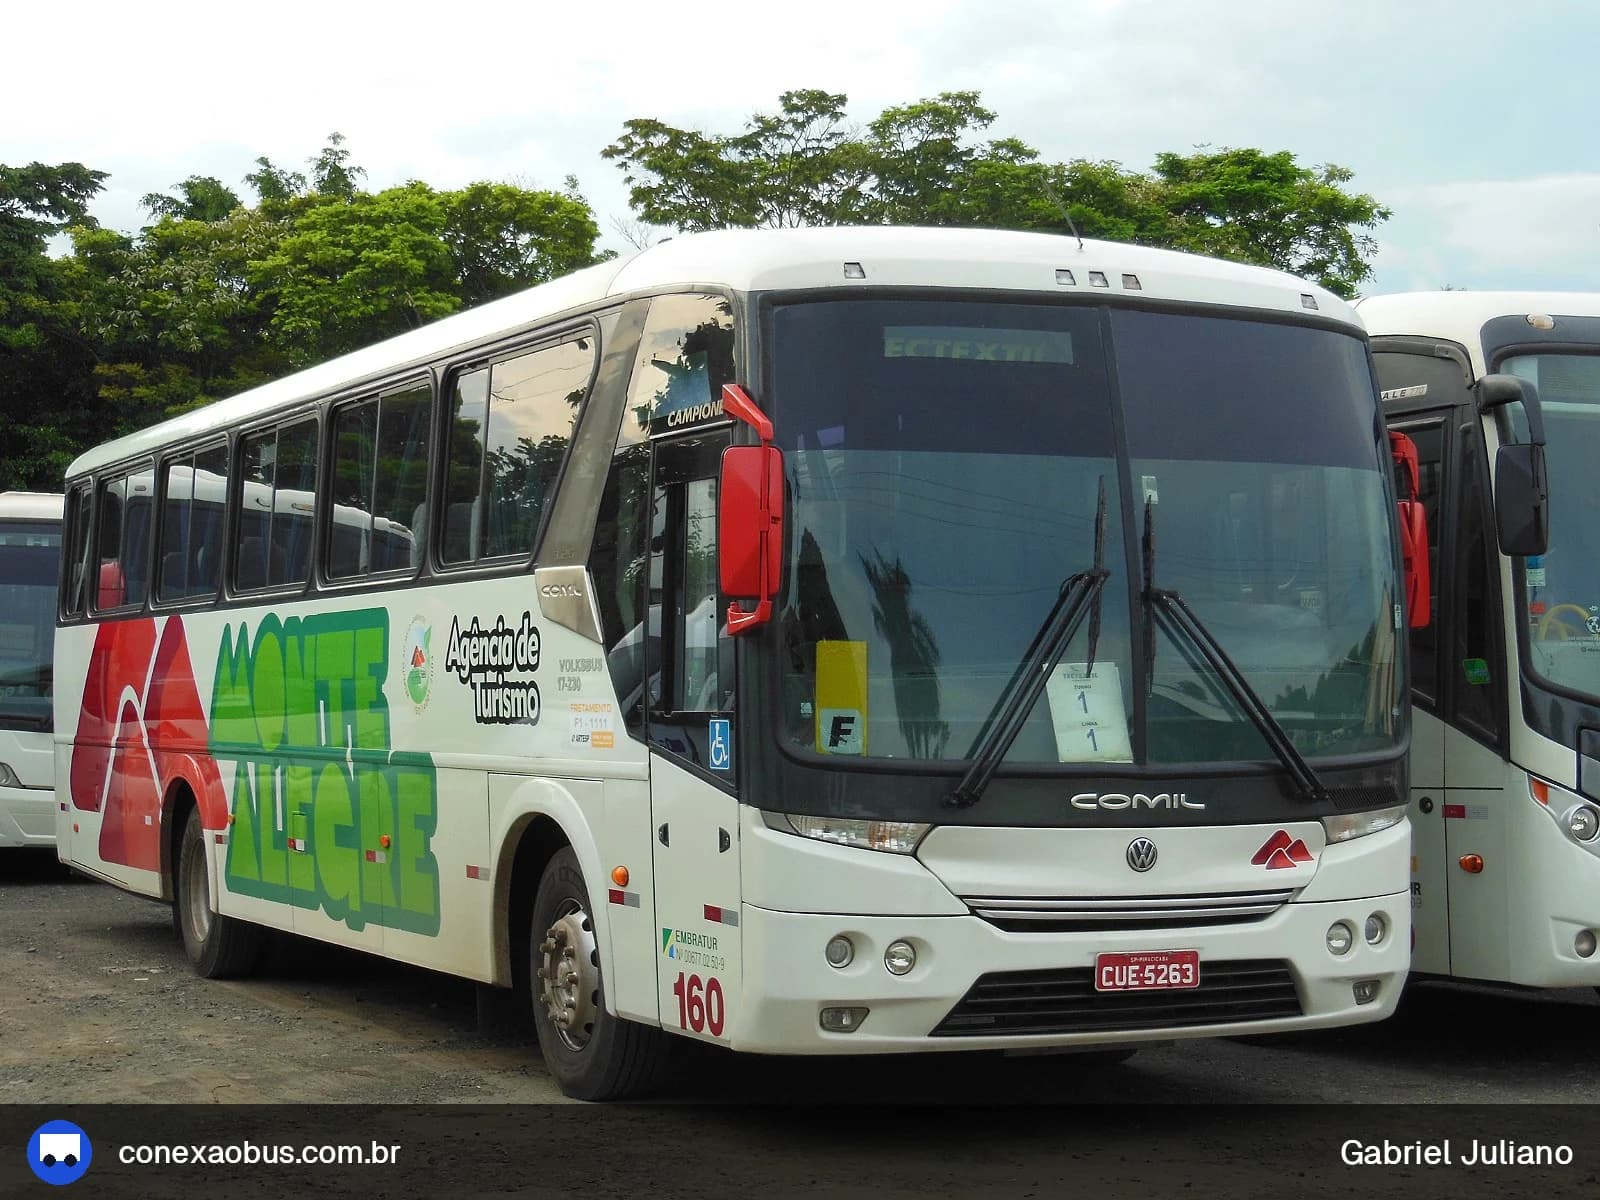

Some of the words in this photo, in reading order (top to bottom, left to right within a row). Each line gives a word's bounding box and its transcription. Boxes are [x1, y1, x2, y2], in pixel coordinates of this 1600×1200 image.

[446, 614, 514, 684] Agência
[515, 611, 540, 672] de
[209, 609, 391, 751] MONTE
[470, 671, 540, 726] Turismo
[1078, 691, 1088, 713] 1
[828, 716, 855, 747] F
[1087, 728, 1098, 752] 1
[1071, 793, 1206, 810] COMIL
[225, 754, 439, 930] ALEGRE
[675, 929, 718, 951] EMBRATUR
[673, 971, 725, 1037] 160
